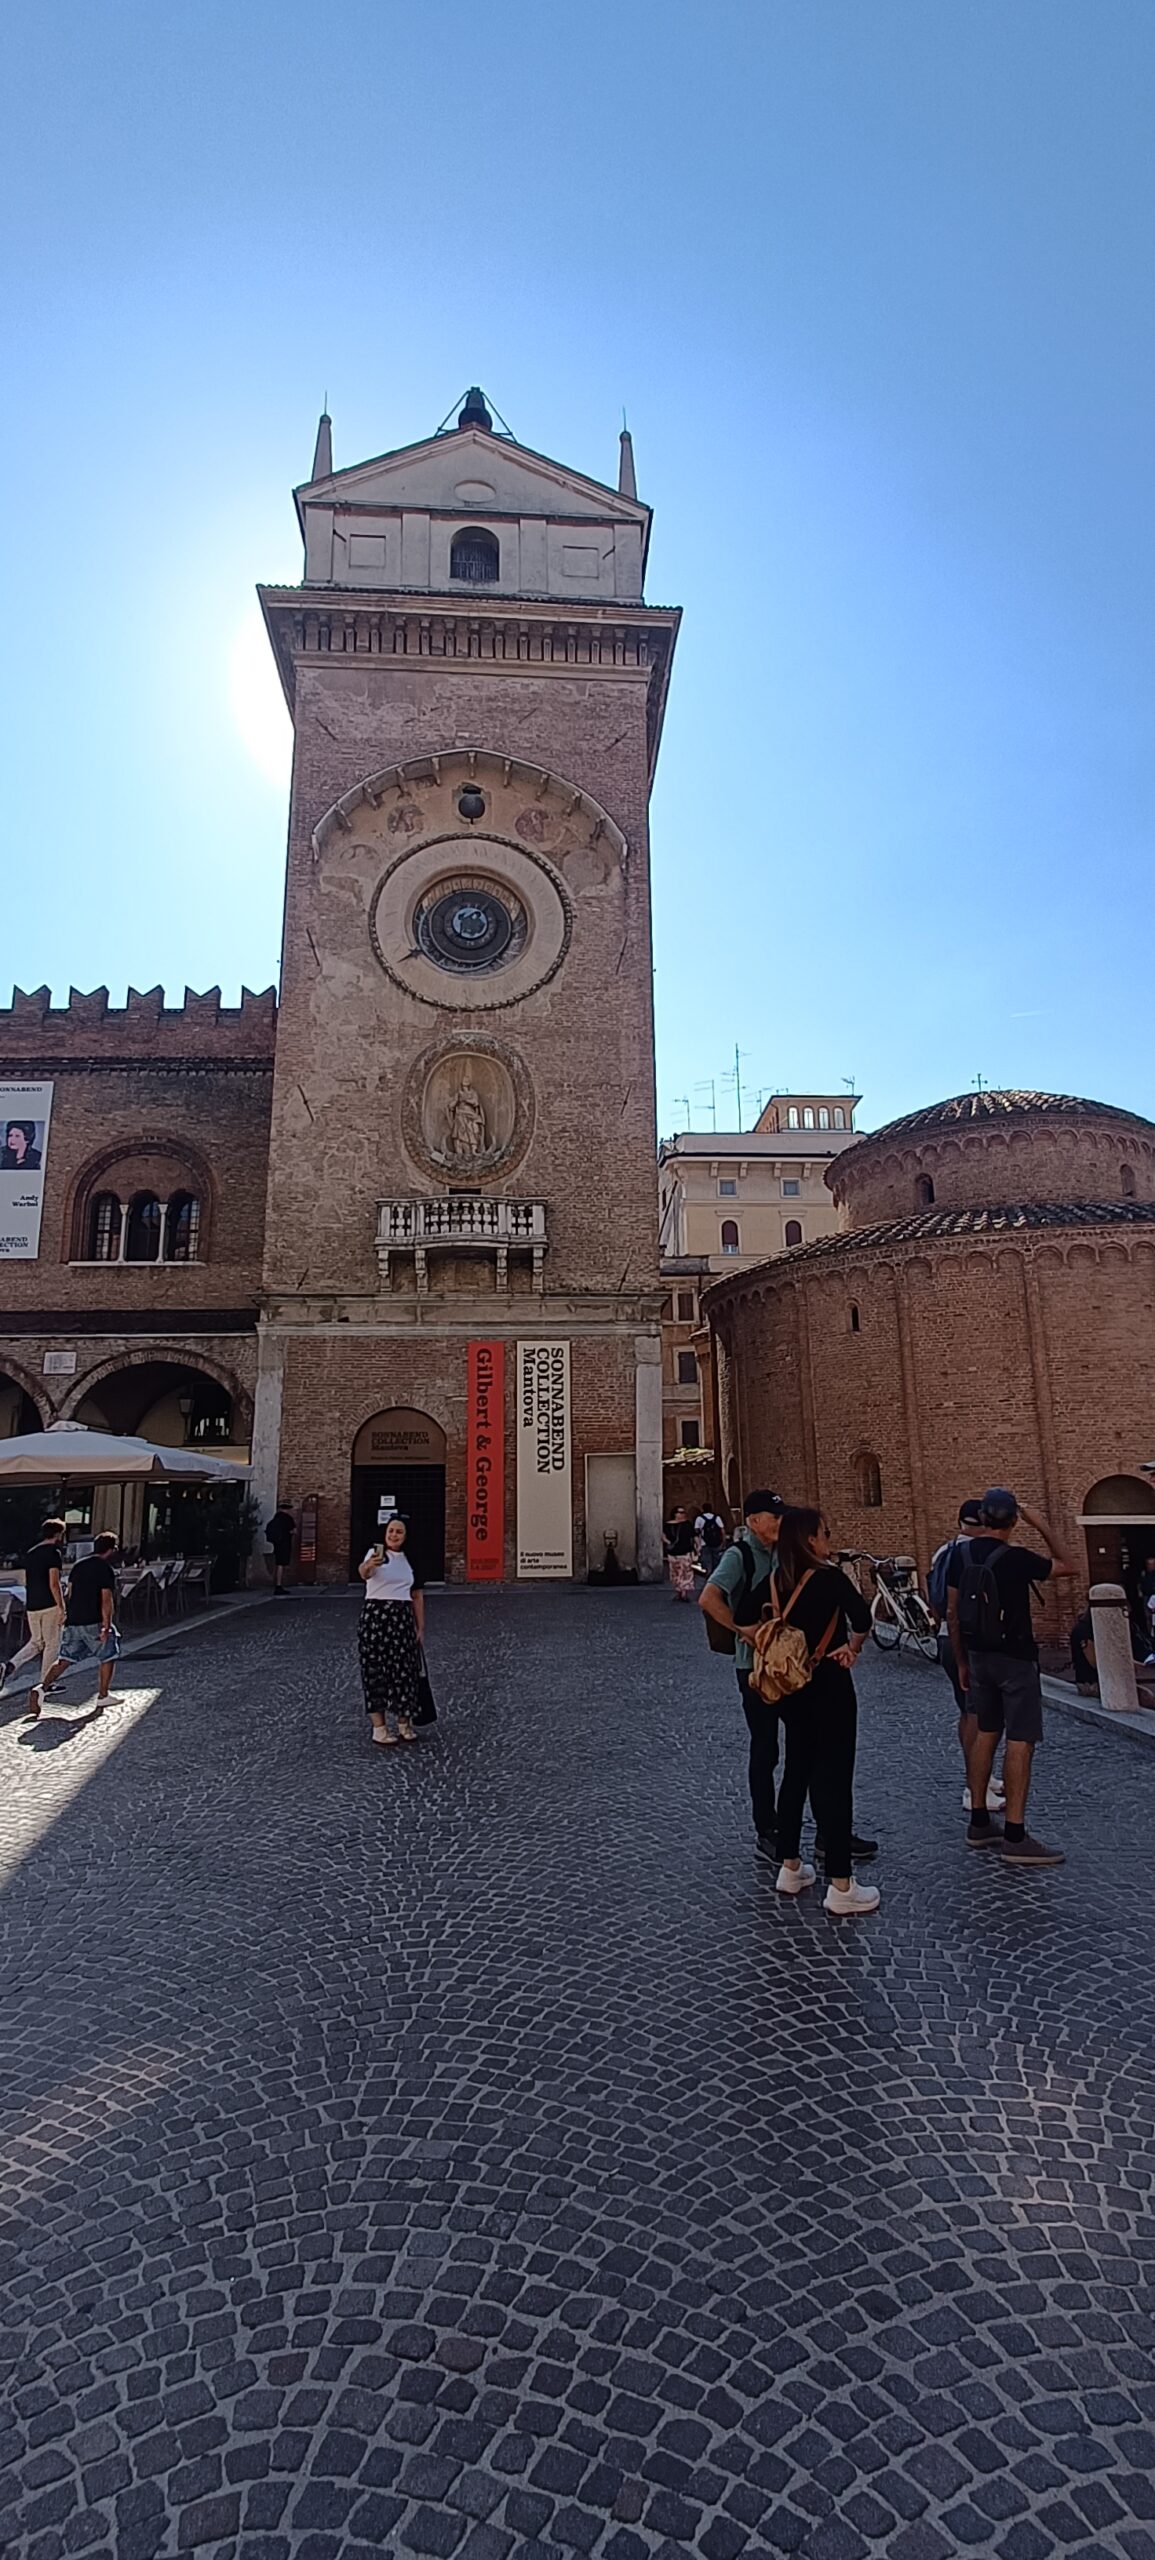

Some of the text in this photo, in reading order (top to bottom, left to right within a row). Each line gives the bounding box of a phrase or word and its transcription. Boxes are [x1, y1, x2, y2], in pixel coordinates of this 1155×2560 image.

[476, 1348, 493, 1429] Gilbert
[523, 1348, 536, 1428] Mantova
[536, 1347, 550, 1474] COLLECTION
[551, 1347, 565, 1471] SONNABEND
[476, 1435, 492, 1450] &
[471, 1456, 492, 1541] George
